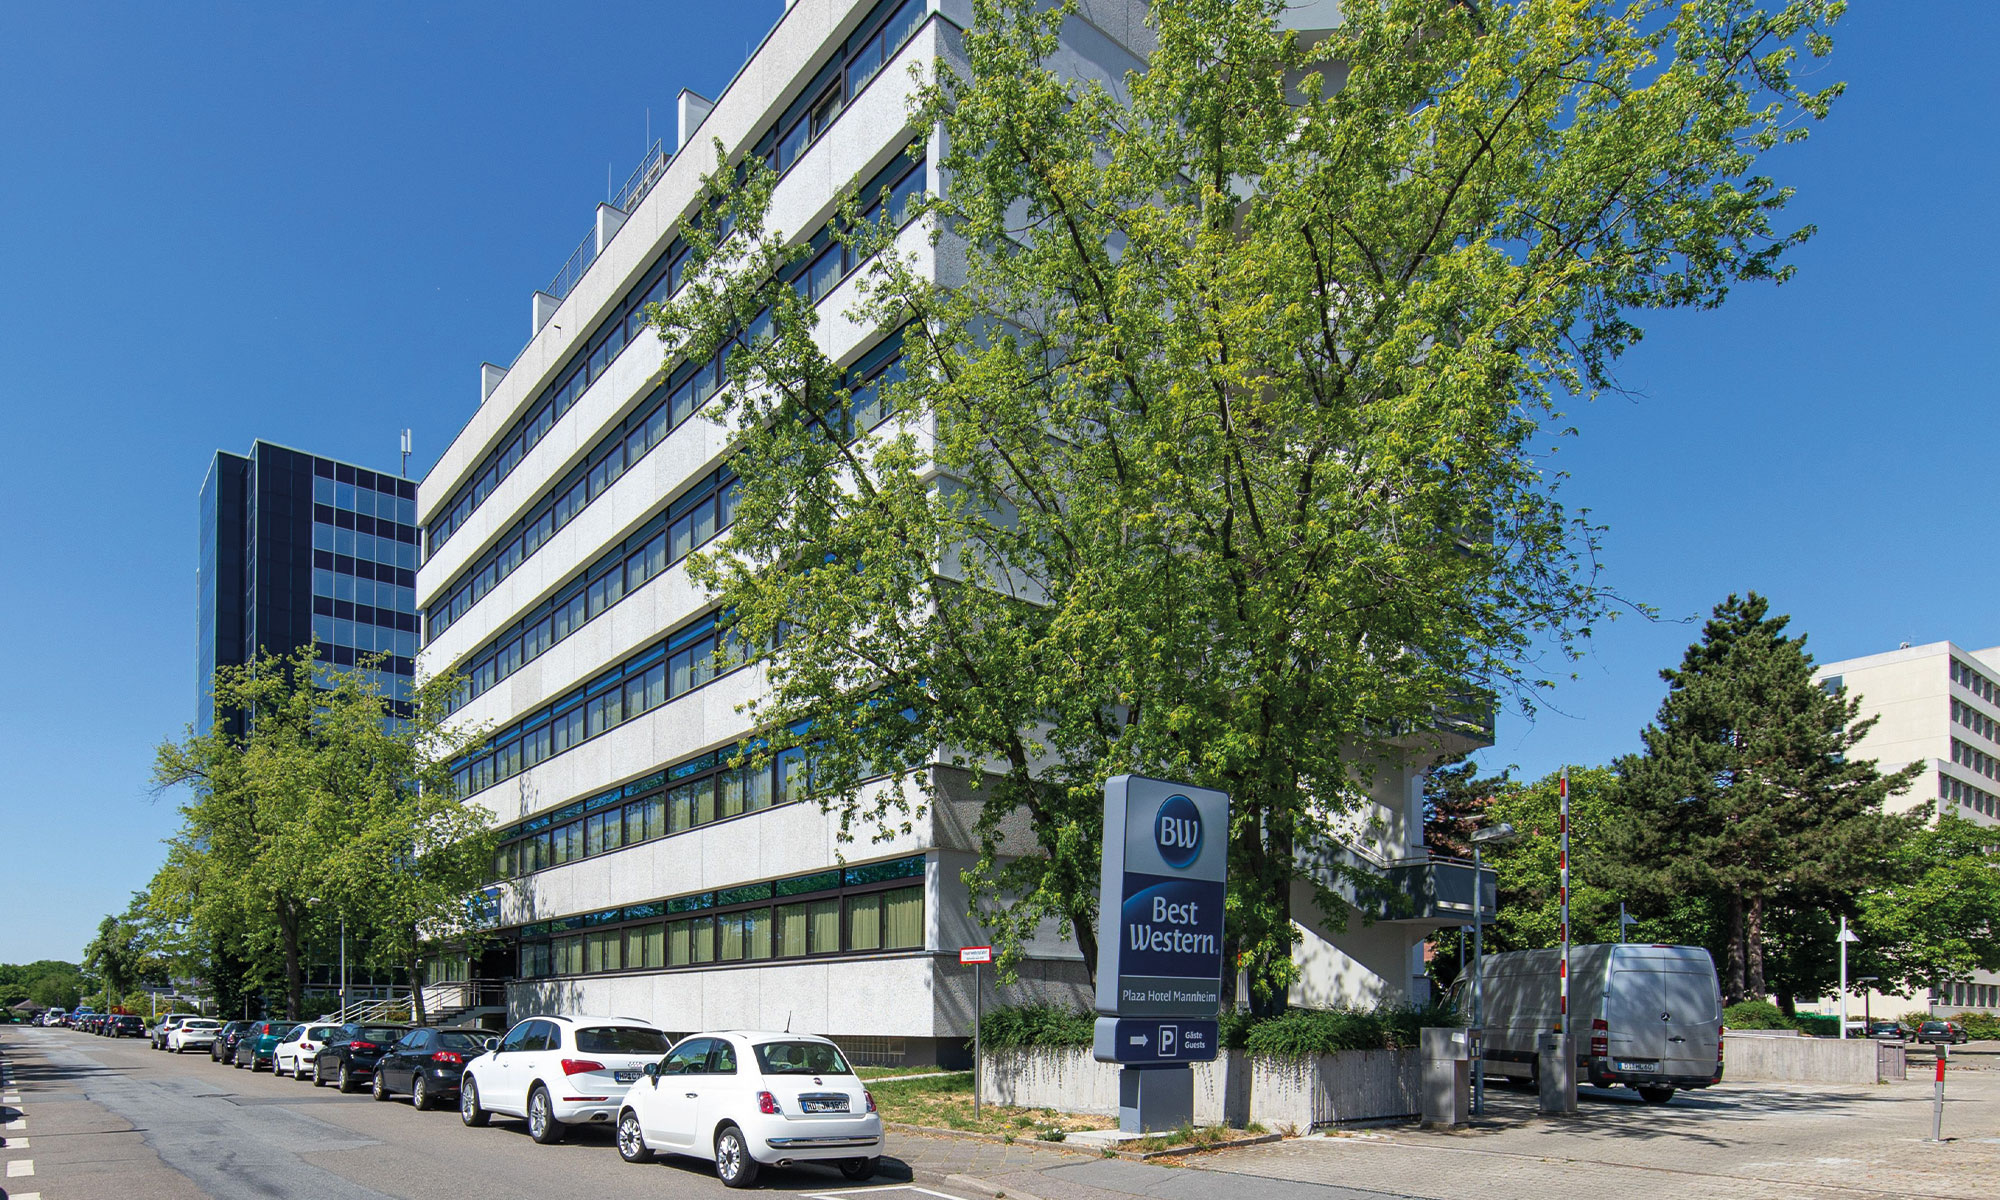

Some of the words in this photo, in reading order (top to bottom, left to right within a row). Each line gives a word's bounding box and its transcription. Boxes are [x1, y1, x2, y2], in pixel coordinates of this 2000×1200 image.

[1160, 816, 1199, 849] BW
[1152, 896, 1199, 926] Best
[1129, 923, 1215, 955] Western
[1122, 989, 1146, 1001] Plaza
[1147, 989, 1172, 1002] Hotel
[1173, 990, 1217, 1002] Mannheim
[1161, 1030, 1175, 1052] P
[1184, 1031, 1203, 1039] Gäste
[1184, 1041, 1206, 1049] Guests
